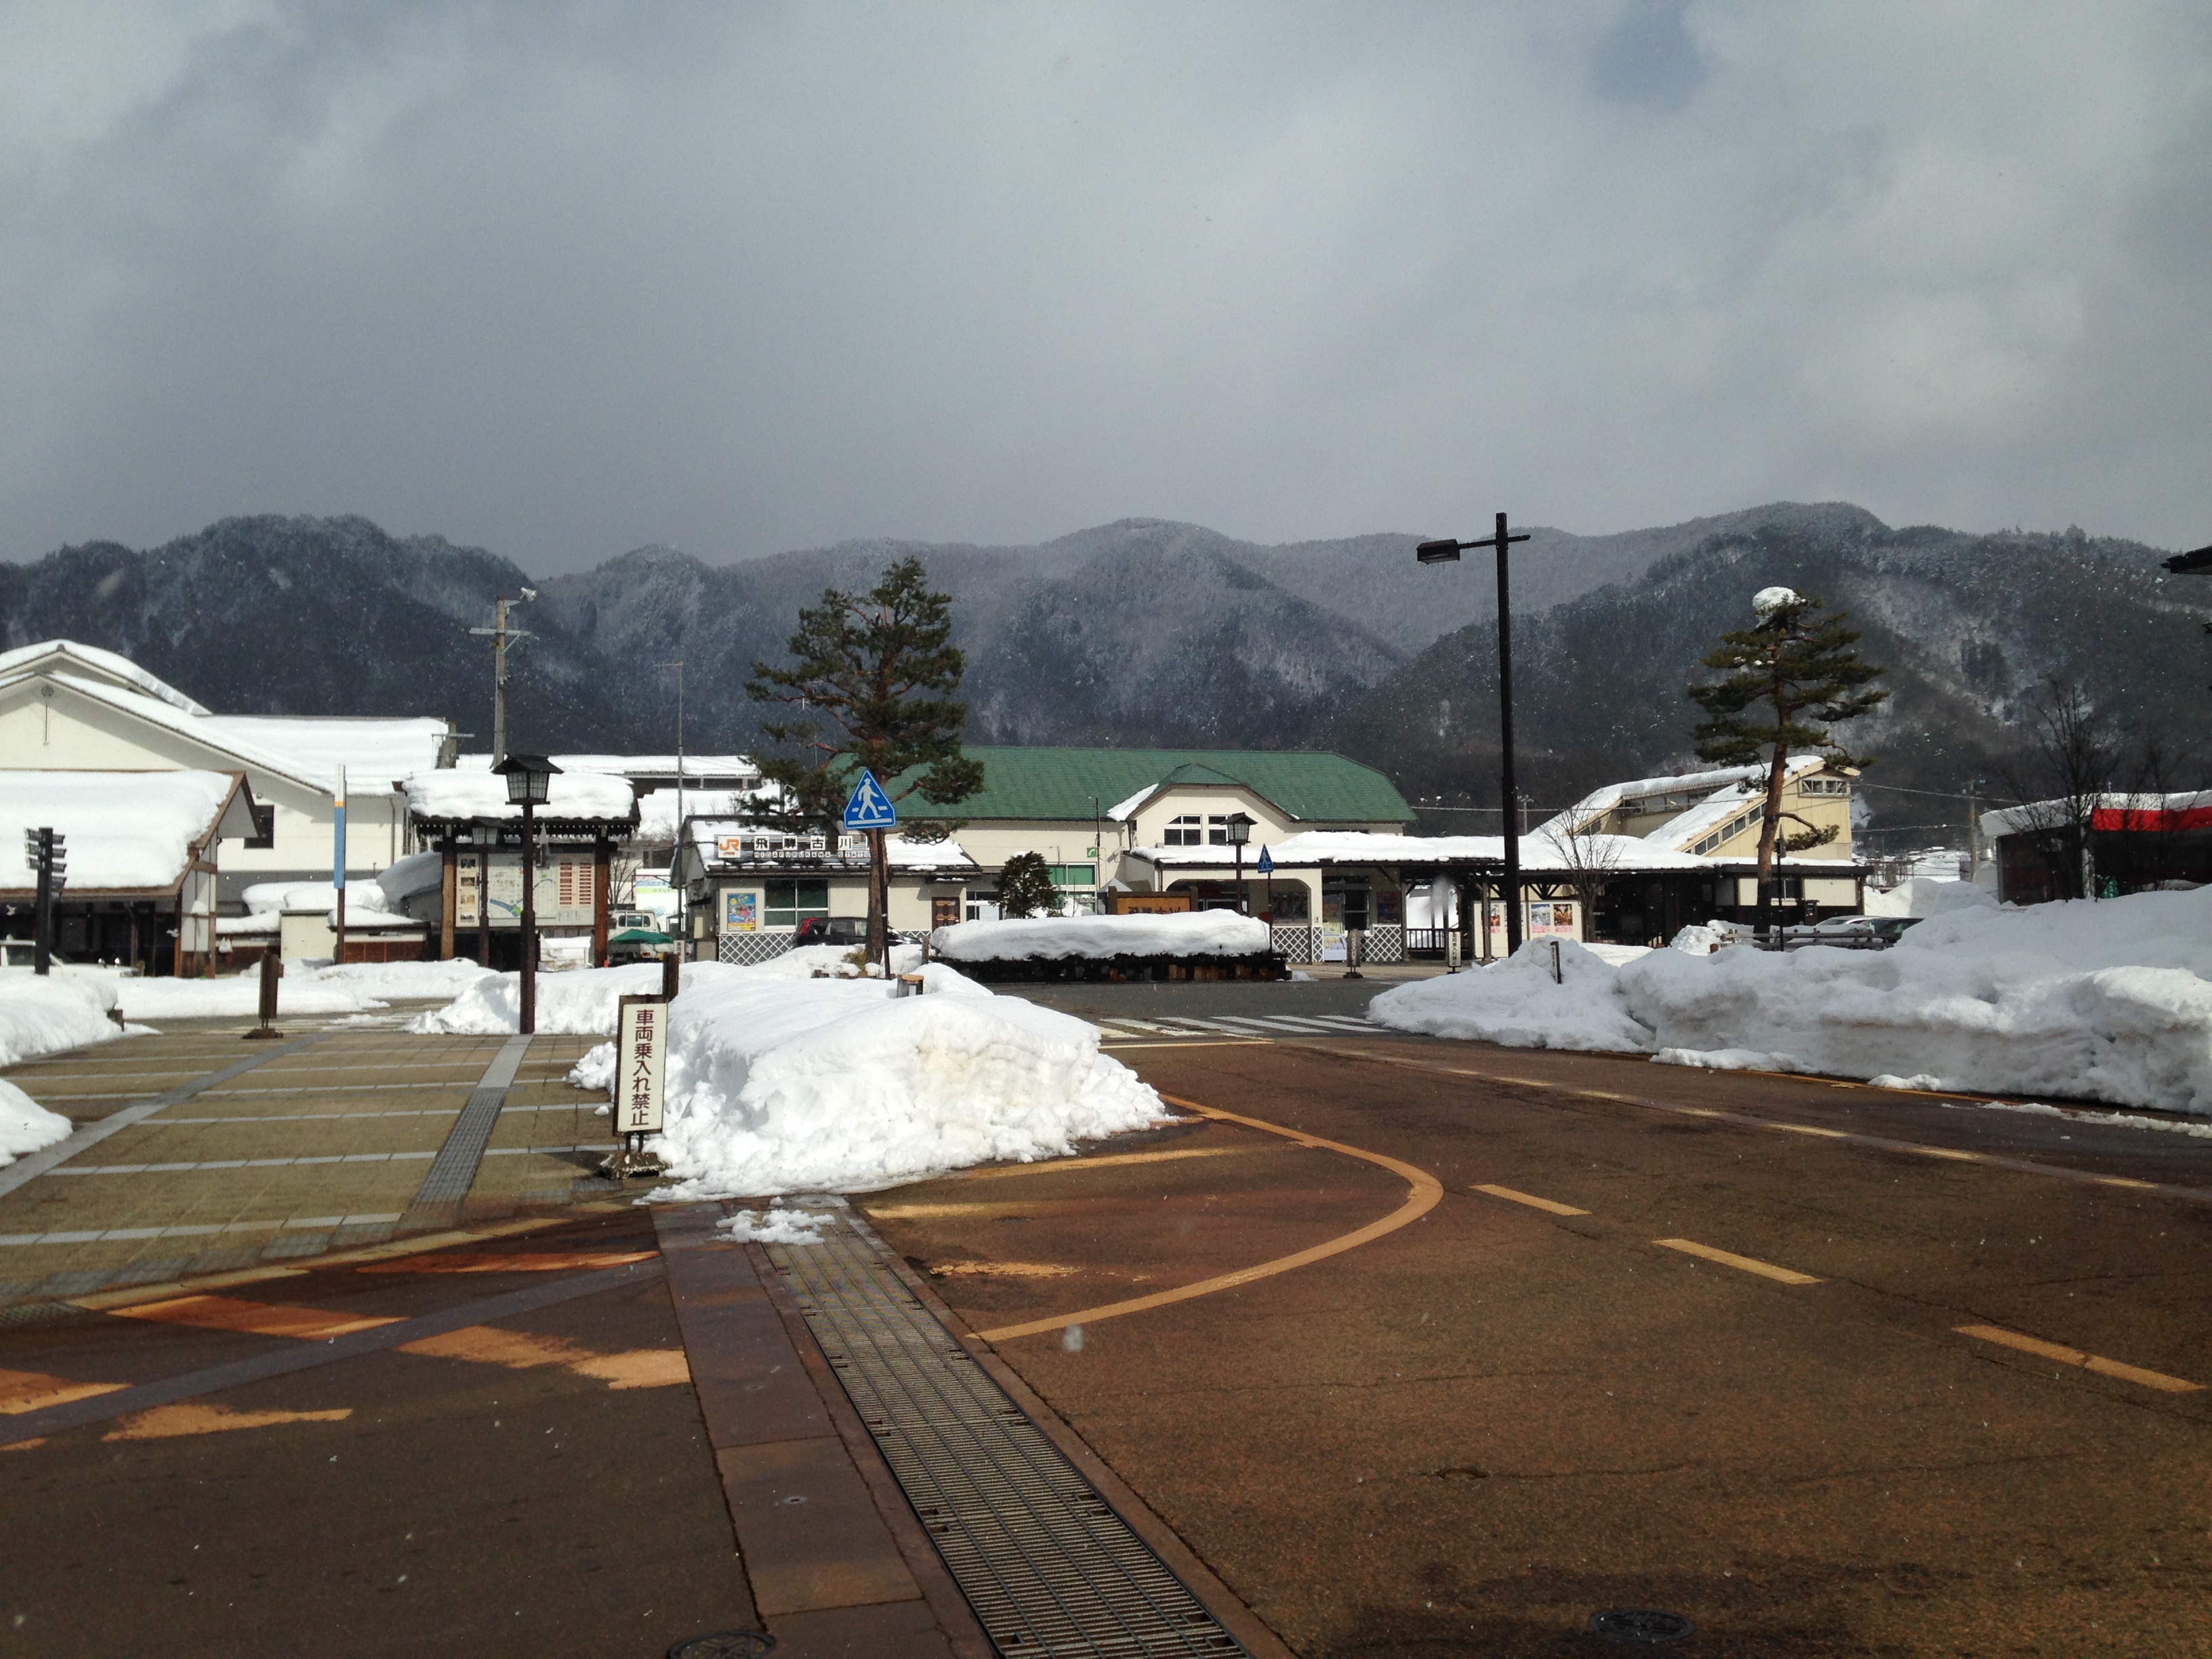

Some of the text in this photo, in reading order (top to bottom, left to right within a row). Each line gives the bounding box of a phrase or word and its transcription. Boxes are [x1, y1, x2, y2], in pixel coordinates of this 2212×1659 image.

[719, 838, 739, 851] JR
[630, 1008, 654, 1126] 車両乗入れ禁止
